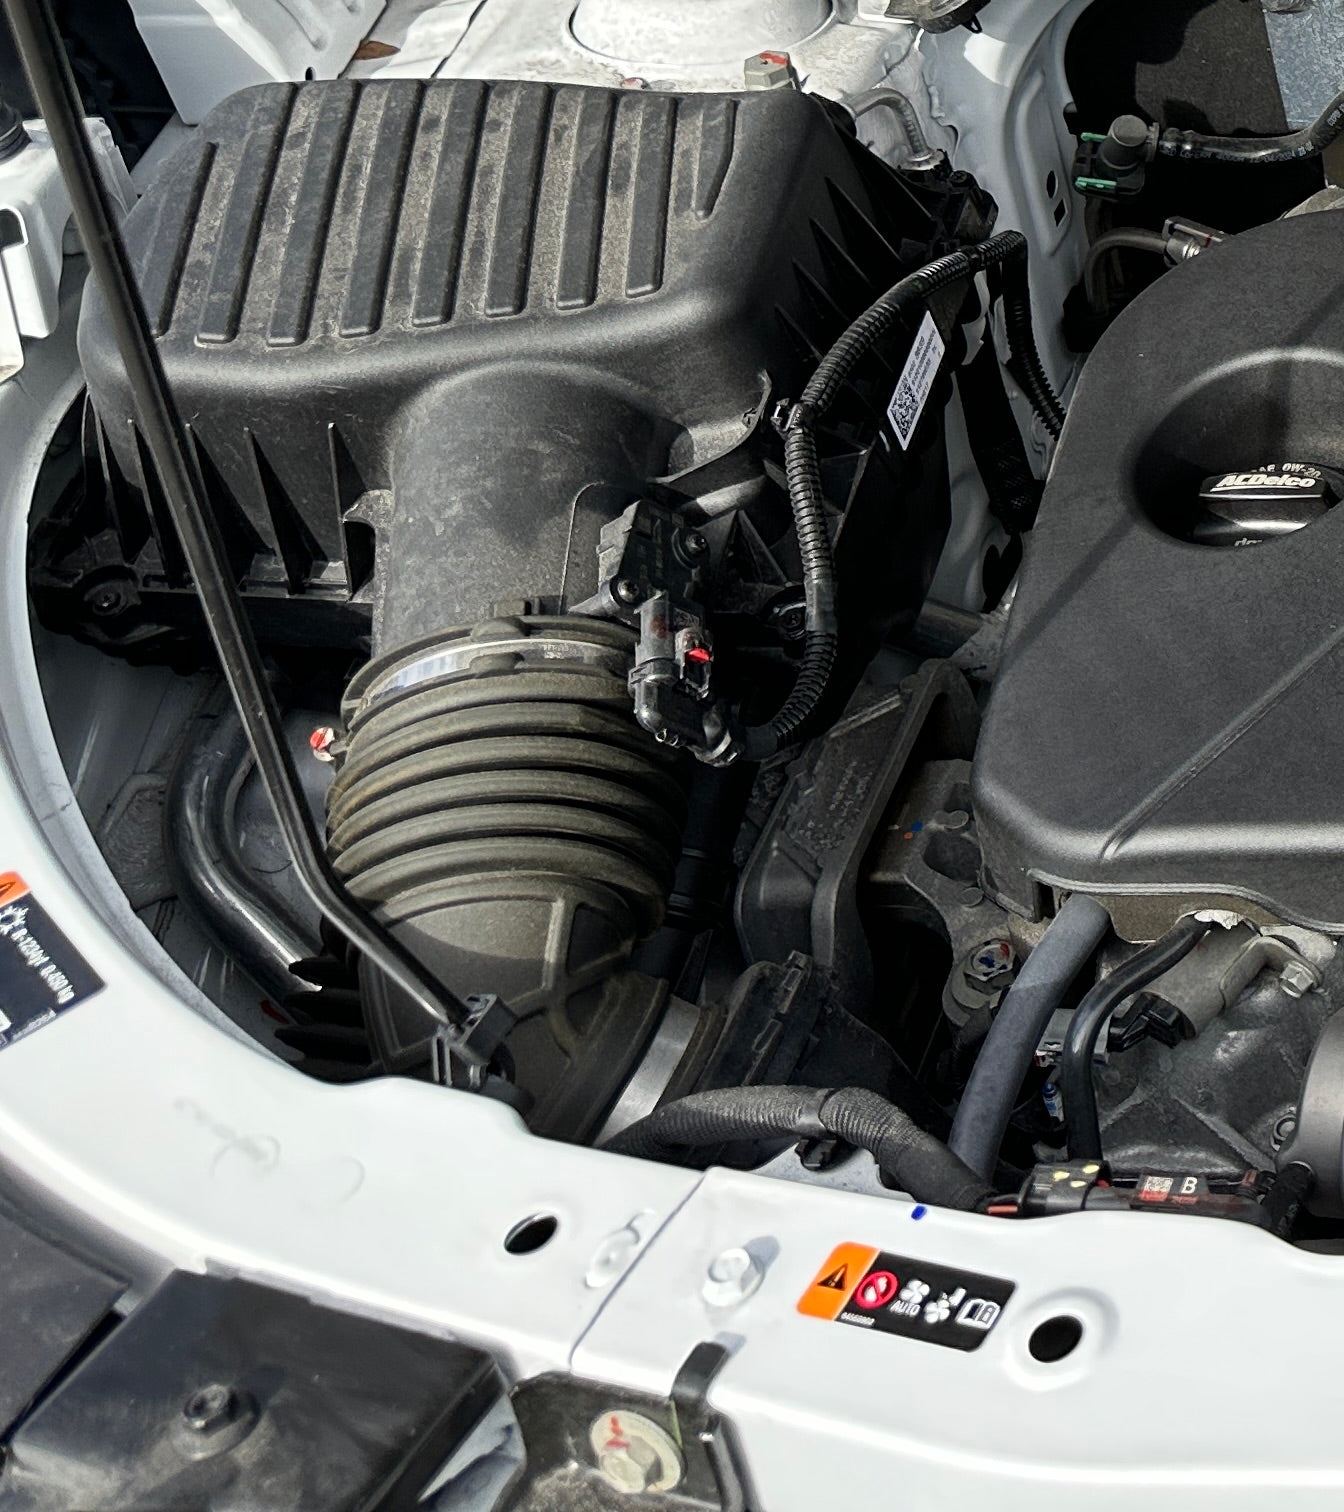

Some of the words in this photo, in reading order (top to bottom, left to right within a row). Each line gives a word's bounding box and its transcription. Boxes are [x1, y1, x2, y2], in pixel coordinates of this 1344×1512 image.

[1215, 474, 1316, 489] ACDelco
[1181, 1176, 1198, 1195] B
[889, 1299, 921, 1317] AUTO
